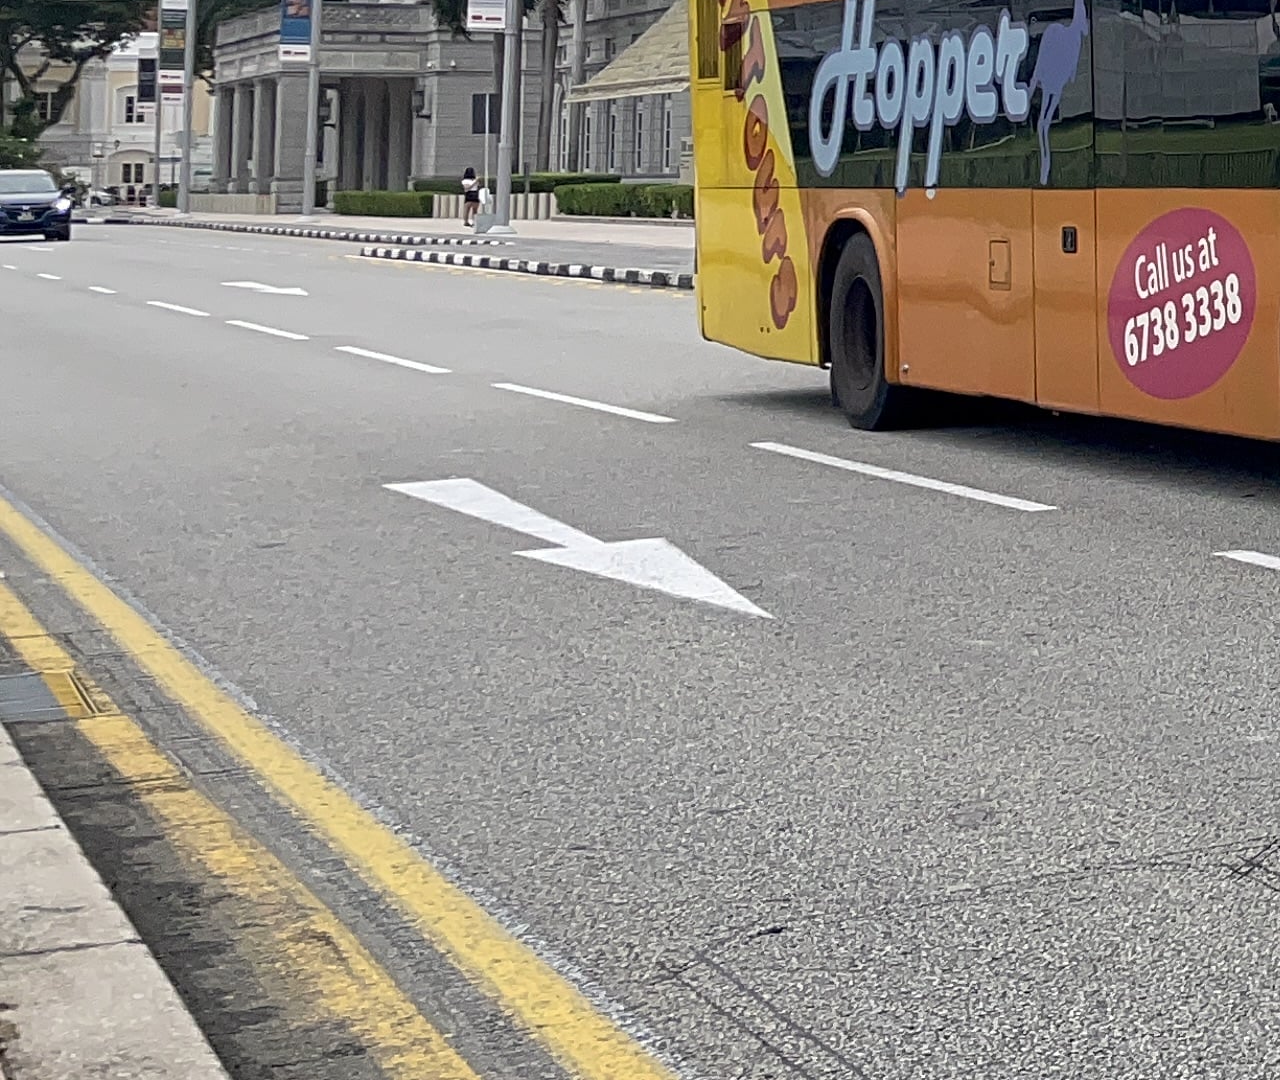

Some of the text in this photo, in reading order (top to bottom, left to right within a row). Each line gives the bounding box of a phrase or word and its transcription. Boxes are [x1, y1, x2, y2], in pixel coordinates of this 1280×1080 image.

[1134, 226, 1219, 299] Call us at
[1124, 273, 1242, 366] 6738 3338
